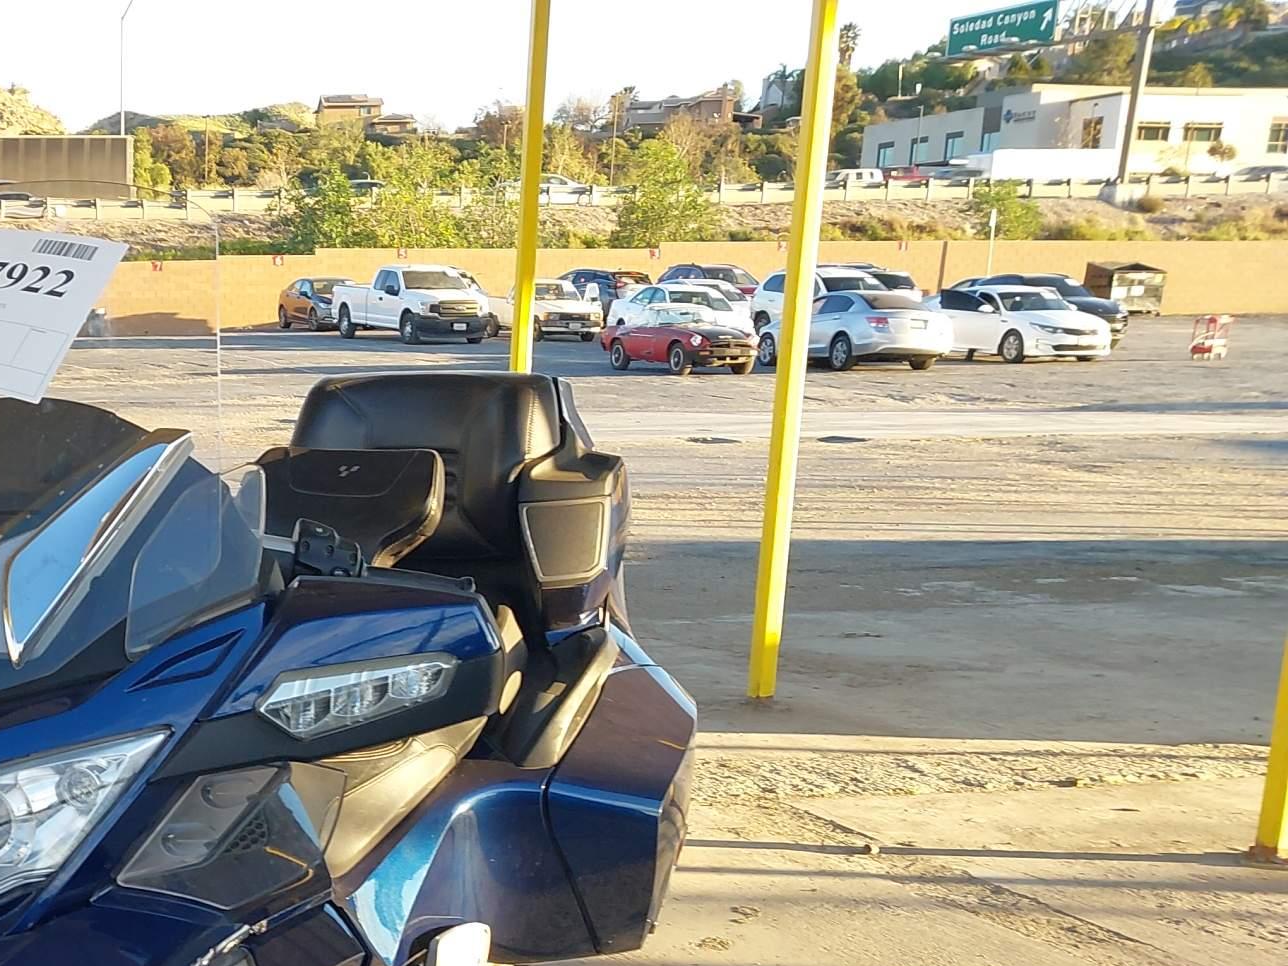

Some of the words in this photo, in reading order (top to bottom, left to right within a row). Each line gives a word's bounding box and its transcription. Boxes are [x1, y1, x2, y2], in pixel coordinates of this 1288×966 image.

[952, 16, 994, 35] Soledad
[996, 9, 1037, 27] Canyon
[980, 31, 1007, 46] Road
